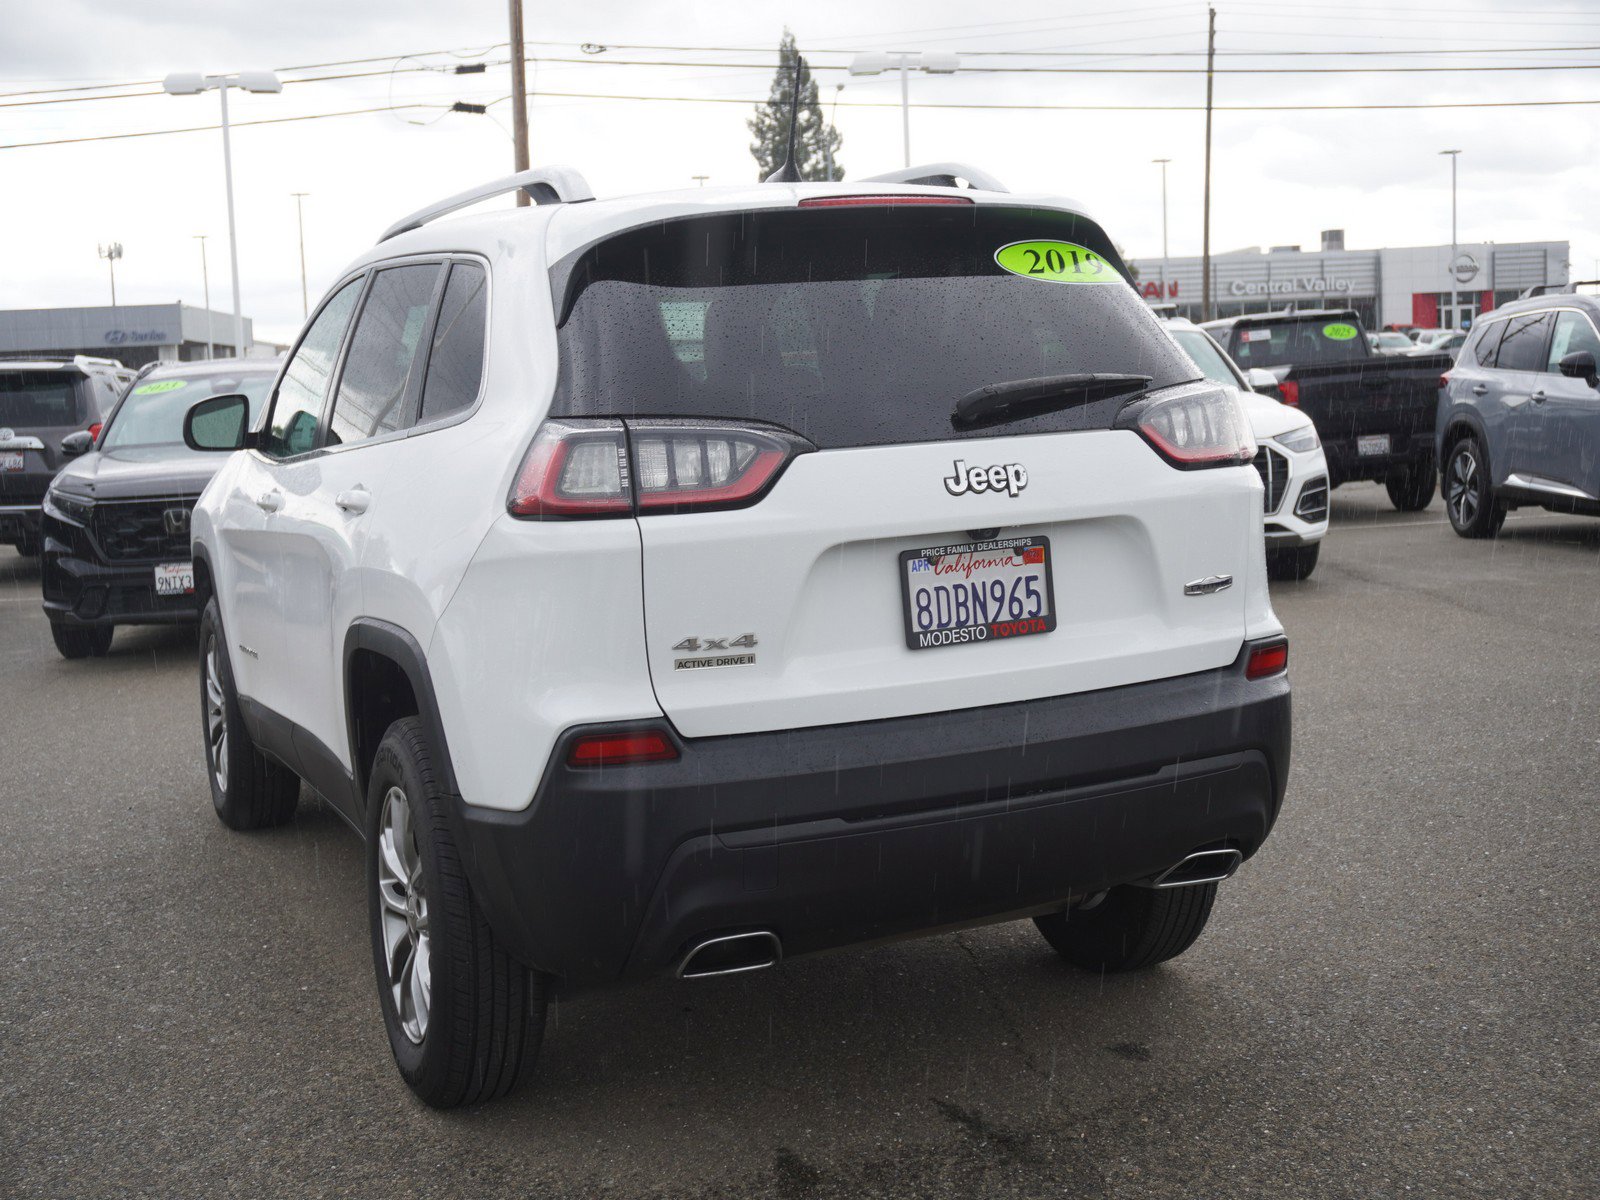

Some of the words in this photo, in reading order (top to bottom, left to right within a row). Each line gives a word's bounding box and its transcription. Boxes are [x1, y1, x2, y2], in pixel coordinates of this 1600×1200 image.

[1022, 249, 1103, 274] 2019
[1231, 278, 1297, 296] Central
[1303, 276, 1356, 294] Valley
[1329, 326, 1351, 337] 2025
[944, 459, 1029, 498] Jeep
[921, 545, 945, 557] PRICE
[947, 543, 975, 555] FAMILY
[977, 538, 1032, 551] DEALERSHIPS
[911, 559, 930, 573] APR
[933, 553, 1023, 579] California
[915, 575, 1042, 631] 8DBN965
[672, 633, 758, 651] 4x4
[919, 626, 987, 647] MODESTO
[990, 619, 1046, 637] TOYOTA
[677, 658, 713, 669] ACTIVE
[716, 656, 745, 666] DRIVE
[747, 655, 754, 664] II
